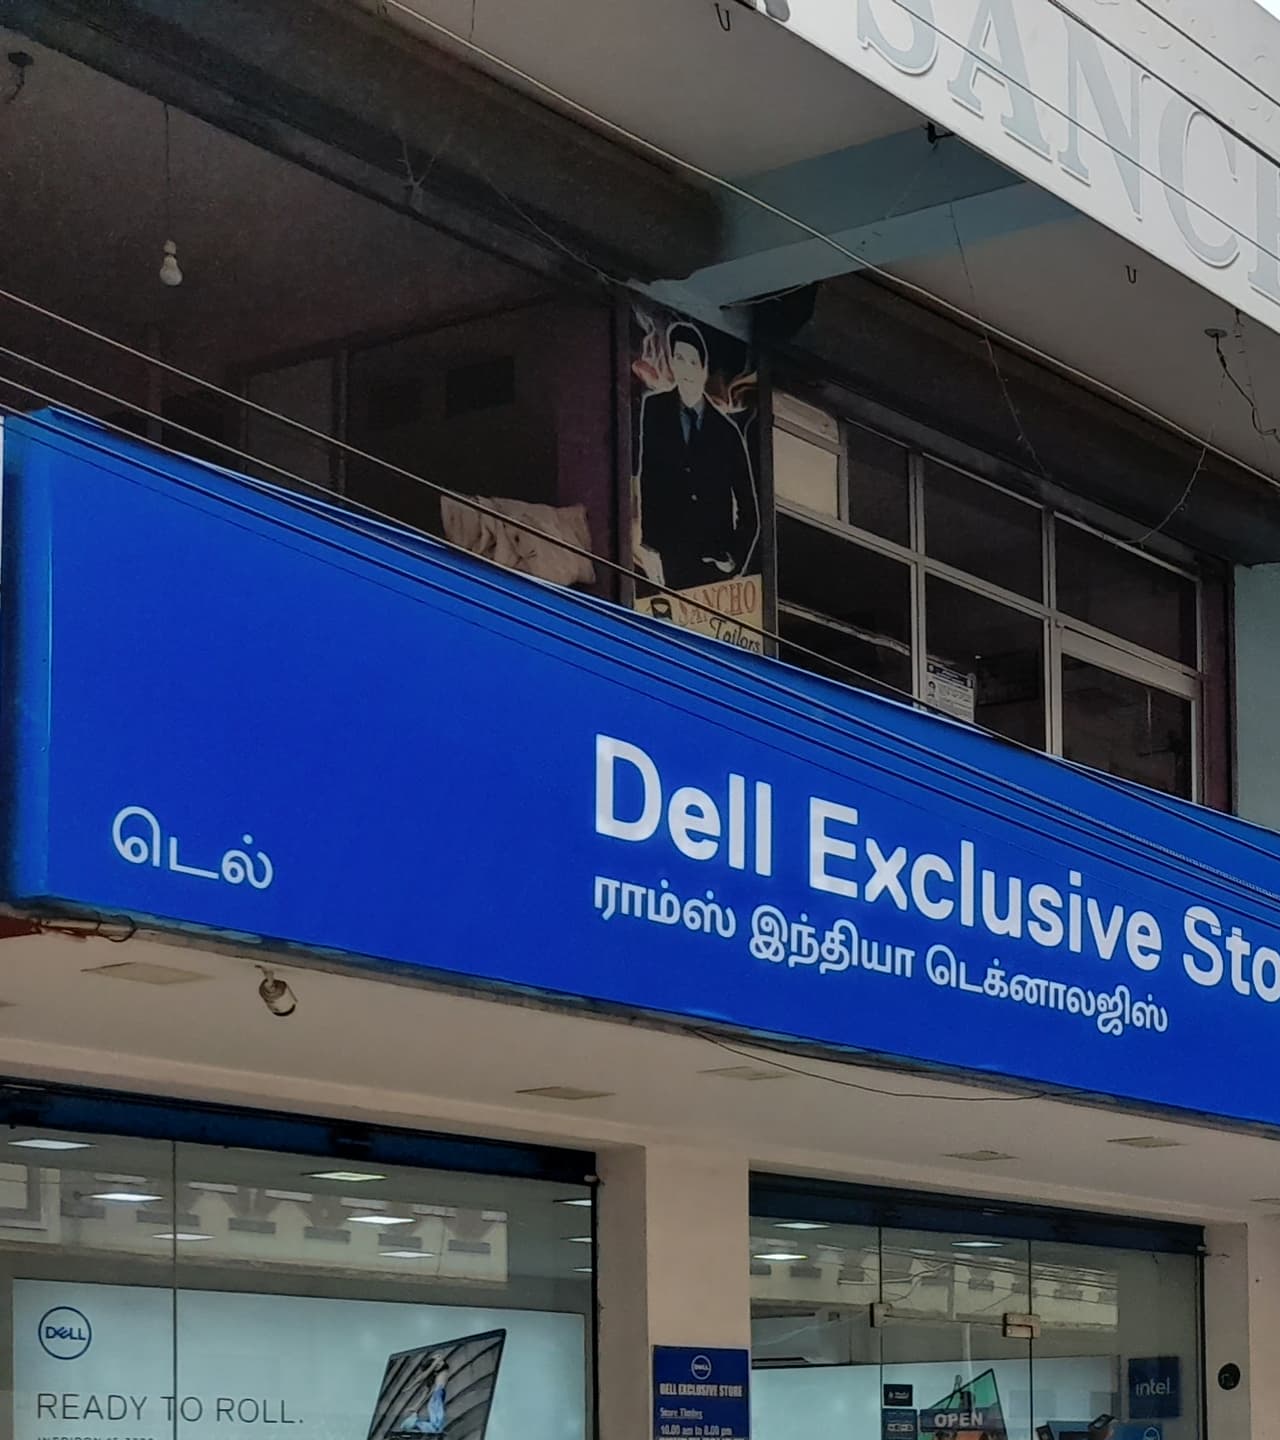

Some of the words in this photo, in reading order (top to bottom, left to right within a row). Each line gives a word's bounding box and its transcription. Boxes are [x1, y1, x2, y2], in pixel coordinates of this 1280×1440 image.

[111, 804, 275, 892] டெல்
[594, 733, 774, 877] Dell
[808, 795, 1162, 972] Exclusive
[594, 873, 737, 940] ராம்ஸ்
[748, 904, 915, 974] இந்தியா
[925, 943, 1170, 1036] டெக்னாலஜிஸ்
[45, 1325, 87, 1341] DELL
[719, 1384, 743, 1397] STORE
[37, 1393, 148, 1421] READY
[160, 1395, 204, 1422] TO
[216, 1398, 304, 1424] ROLL.
[934, 1410, 984, 1428] OPEN
